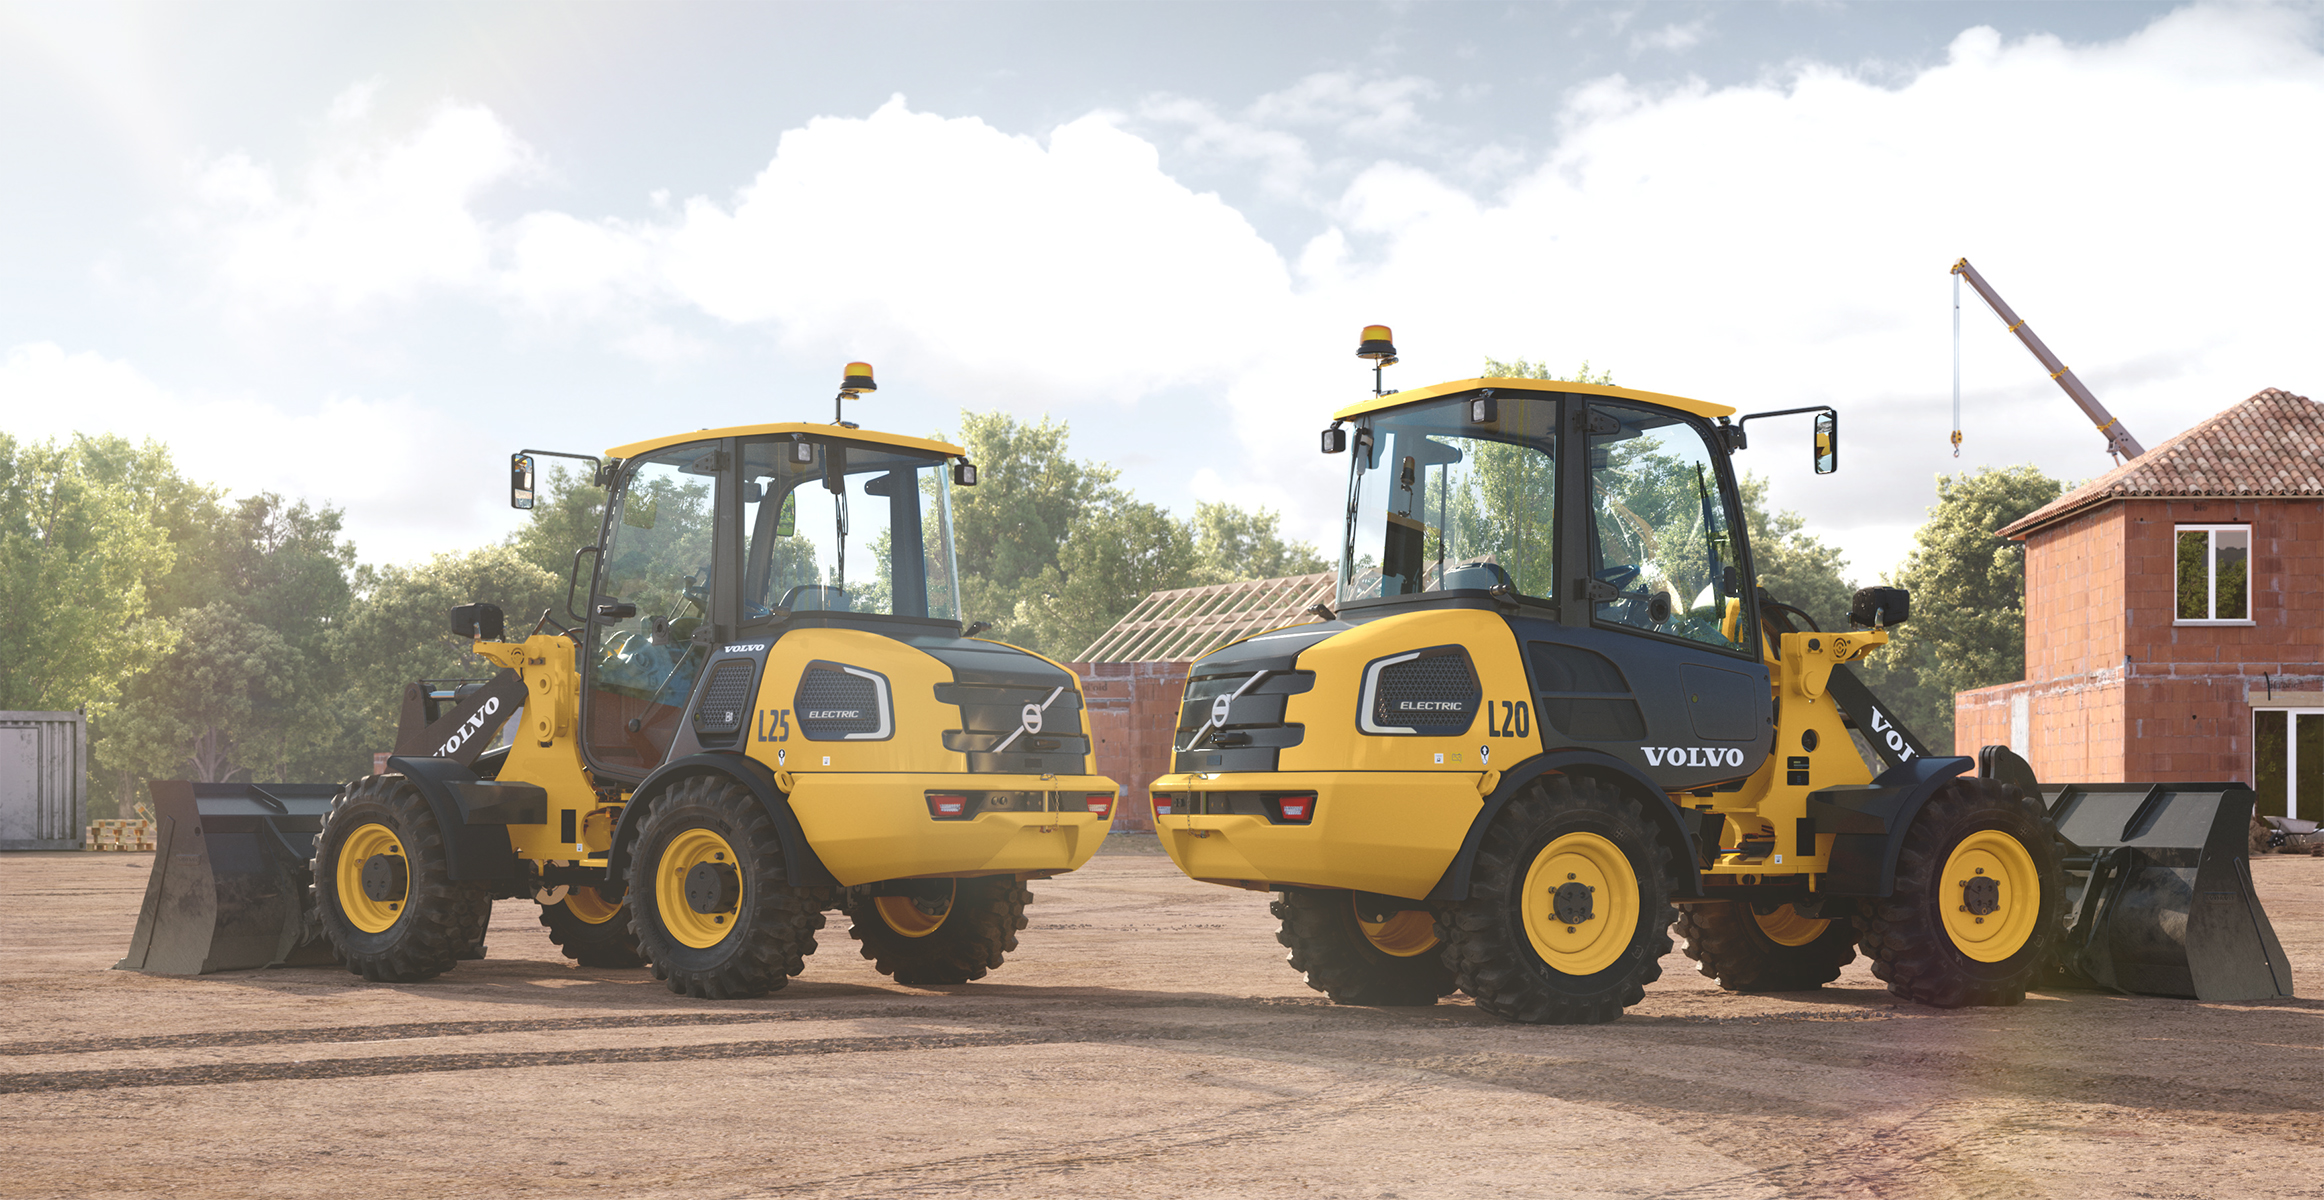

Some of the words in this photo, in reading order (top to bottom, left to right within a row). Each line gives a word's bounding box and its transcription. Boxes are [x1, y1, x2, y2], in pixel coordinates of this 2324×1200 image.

[724, 644, 765, 653] VOLVO
[809, 710, 859, 719] ELECTRIC
[1400, 701, 1462, 711] ELECTRIC
[758, 709, 790, 742] L25
[1488, 700, 1530, 738] L20
[1871, 705, 1919, 762] VOL
[1641, 746, 1744, 767] VOLVO
